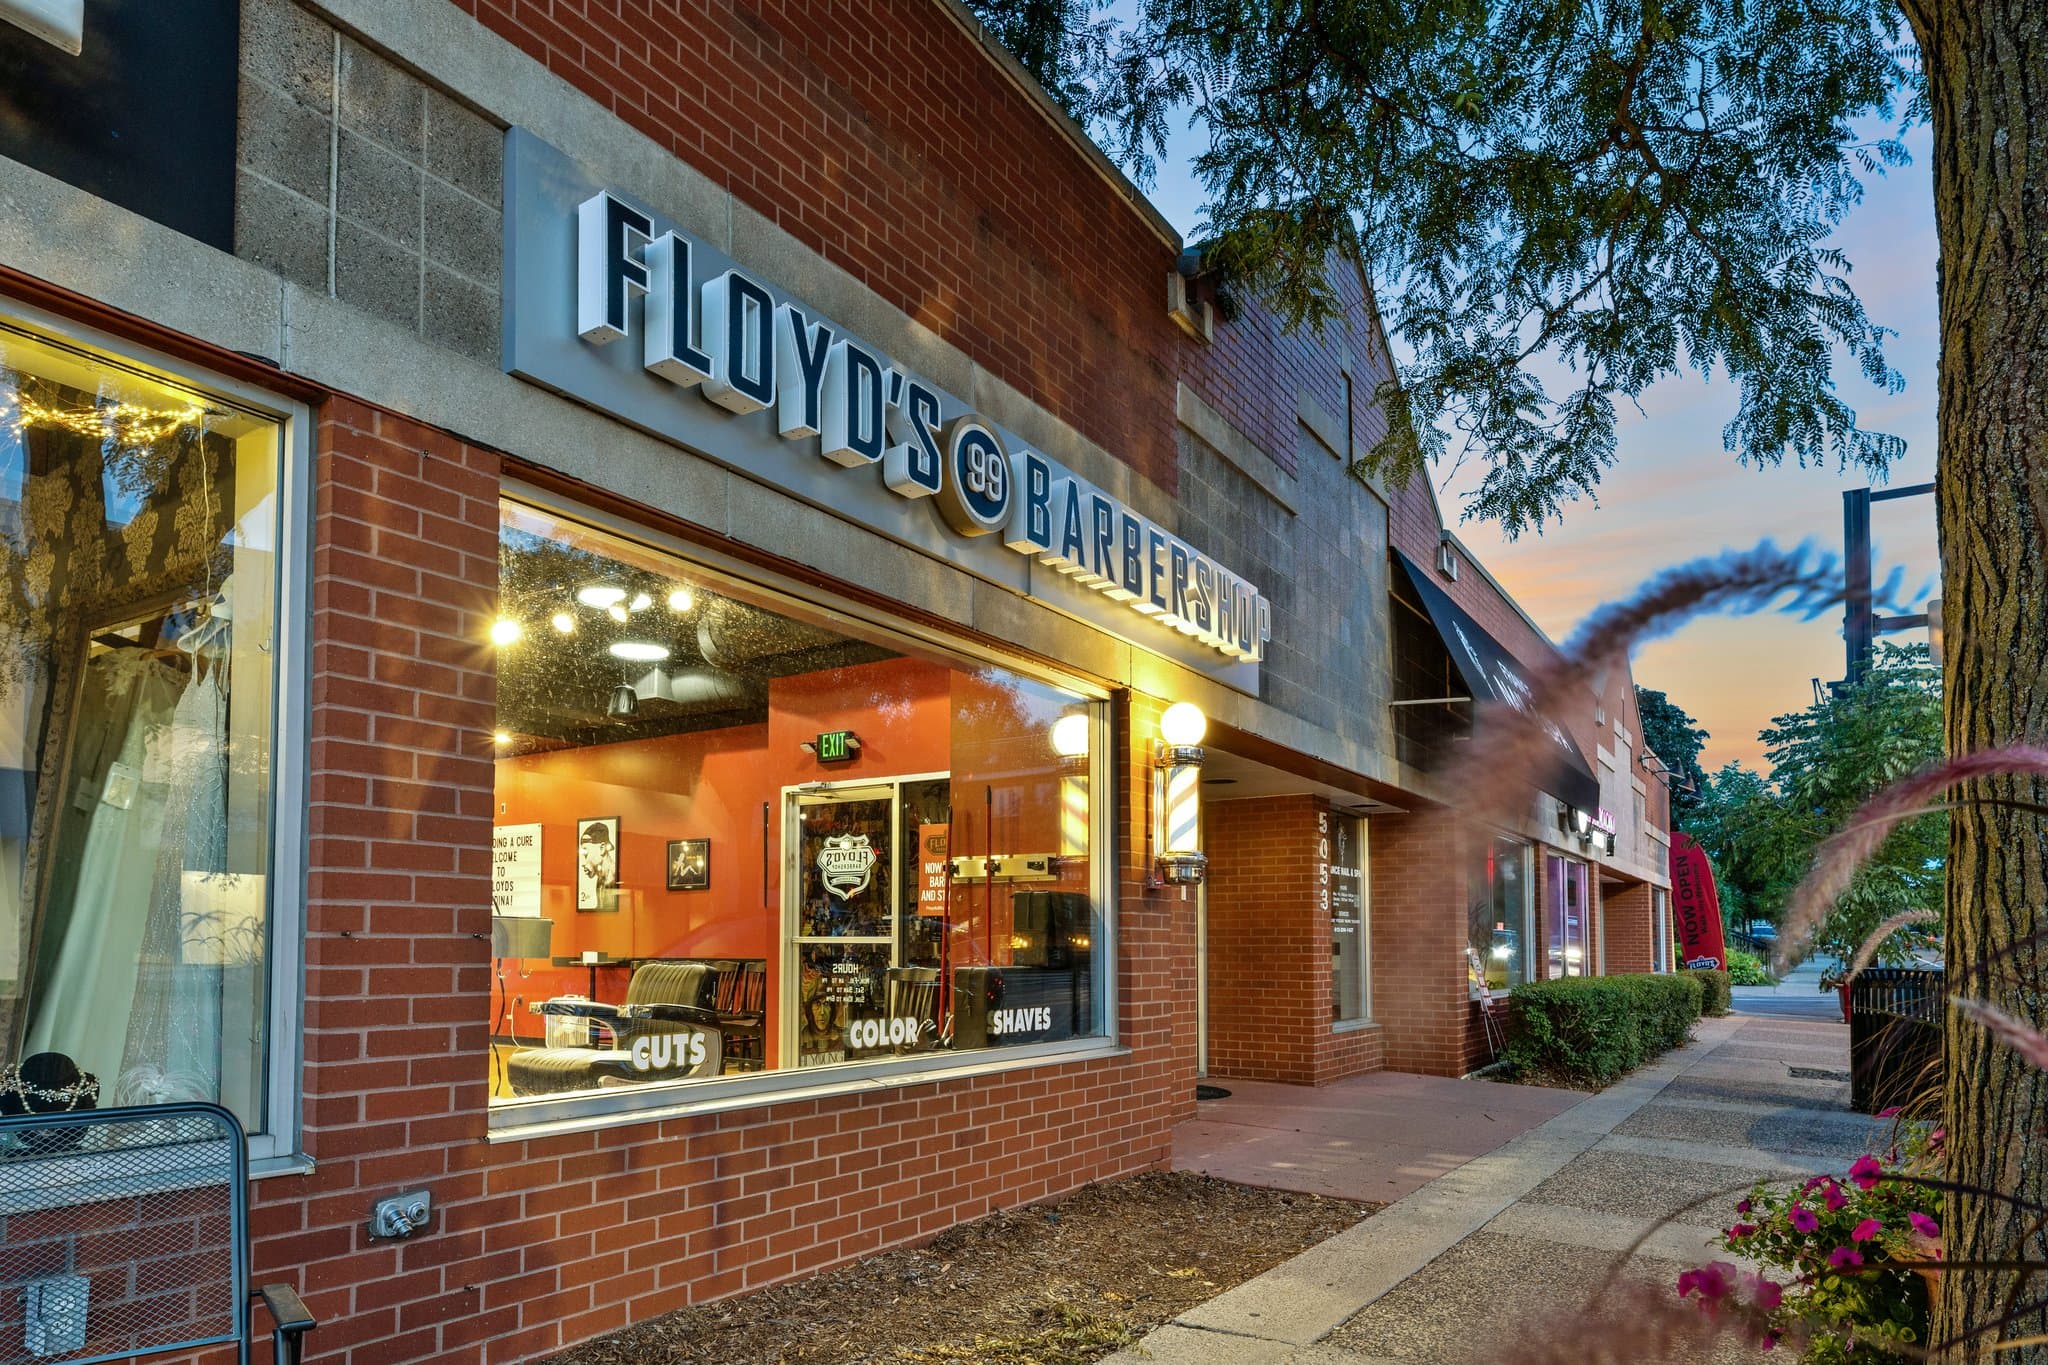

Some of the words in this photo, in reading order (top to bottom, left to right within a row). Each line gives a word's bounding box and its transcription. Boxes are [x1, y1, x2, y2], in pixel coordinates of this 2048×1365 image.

[579, 190, 942, 497] FLOYD'S
[967, 443, 1004, 502] 99
[1008, 449, 1271, 662] BARBERSHOP
[822, 732, 846, 758] EXIT
[510, 837, 514, 847] A
[516, 835, 533, 847] CURE
[497, 866, 506, 877] TO
[925, 862, 943, 874] NOW
[1676, 855, 1694, 901] OPEN
[921, 890, 936, 902] AND
[1682, 905, 1699, 946] NOW
[849, 1016, 918, 1049] COLOR
[993, 1006, 1051, 1036] SHAVES
[632, 1032, 706, 1071] CUTS
